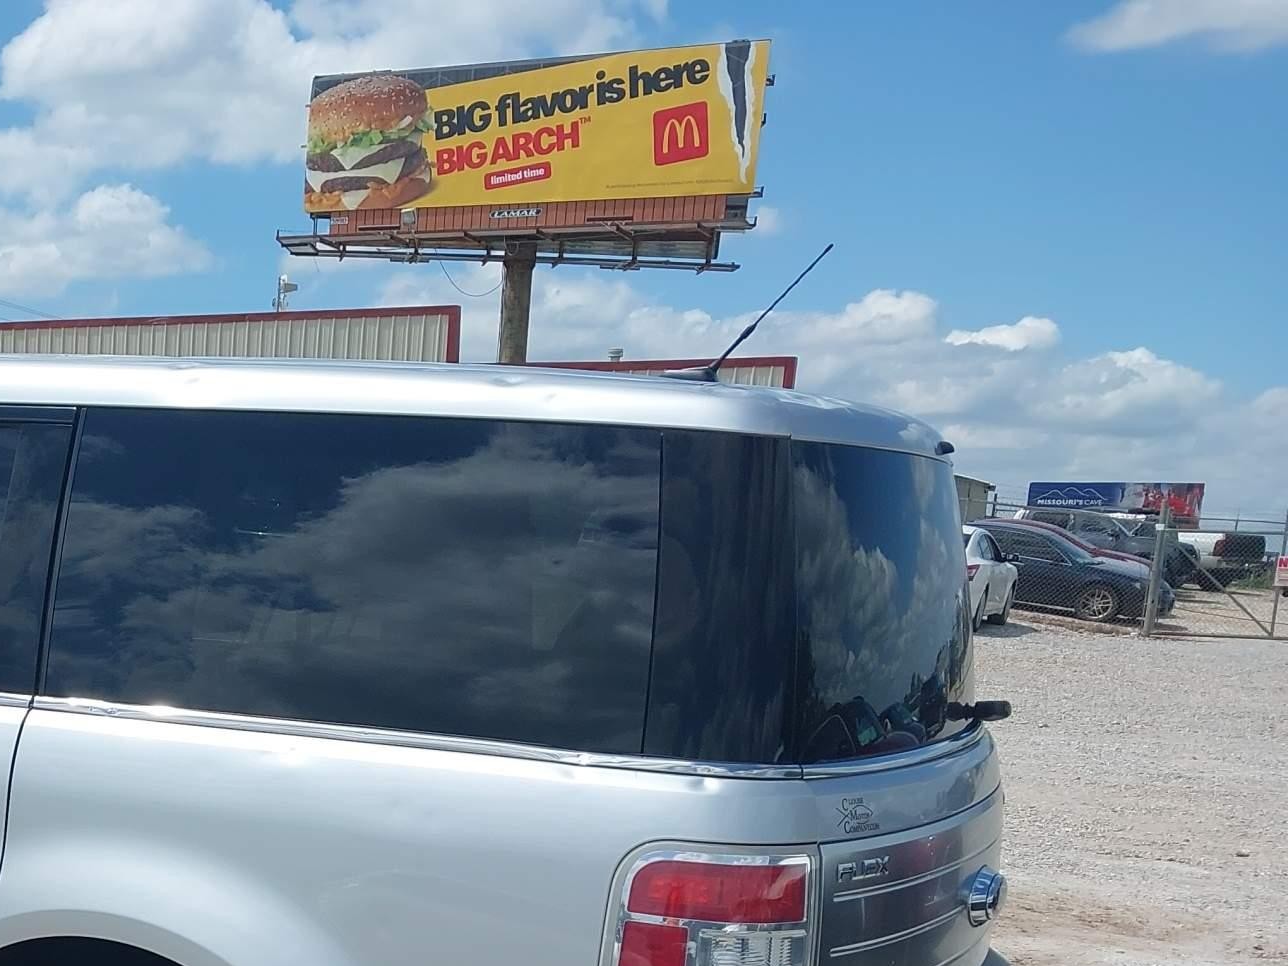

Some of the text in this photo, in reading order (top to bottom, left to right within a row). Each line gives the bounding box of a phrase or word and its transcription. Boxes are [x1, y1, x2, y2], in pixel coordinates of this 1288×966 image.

[434, 58, 710, 140] BIG flavor is here
[436, 141, 487, 176] BIG
[490, 166, 545, 185] limited time
[493, 208, 538, 218] LAMAR
[1037, 498, 1083, 506] MISSOURI'S
[838, 855, 890, 883] FLEX
